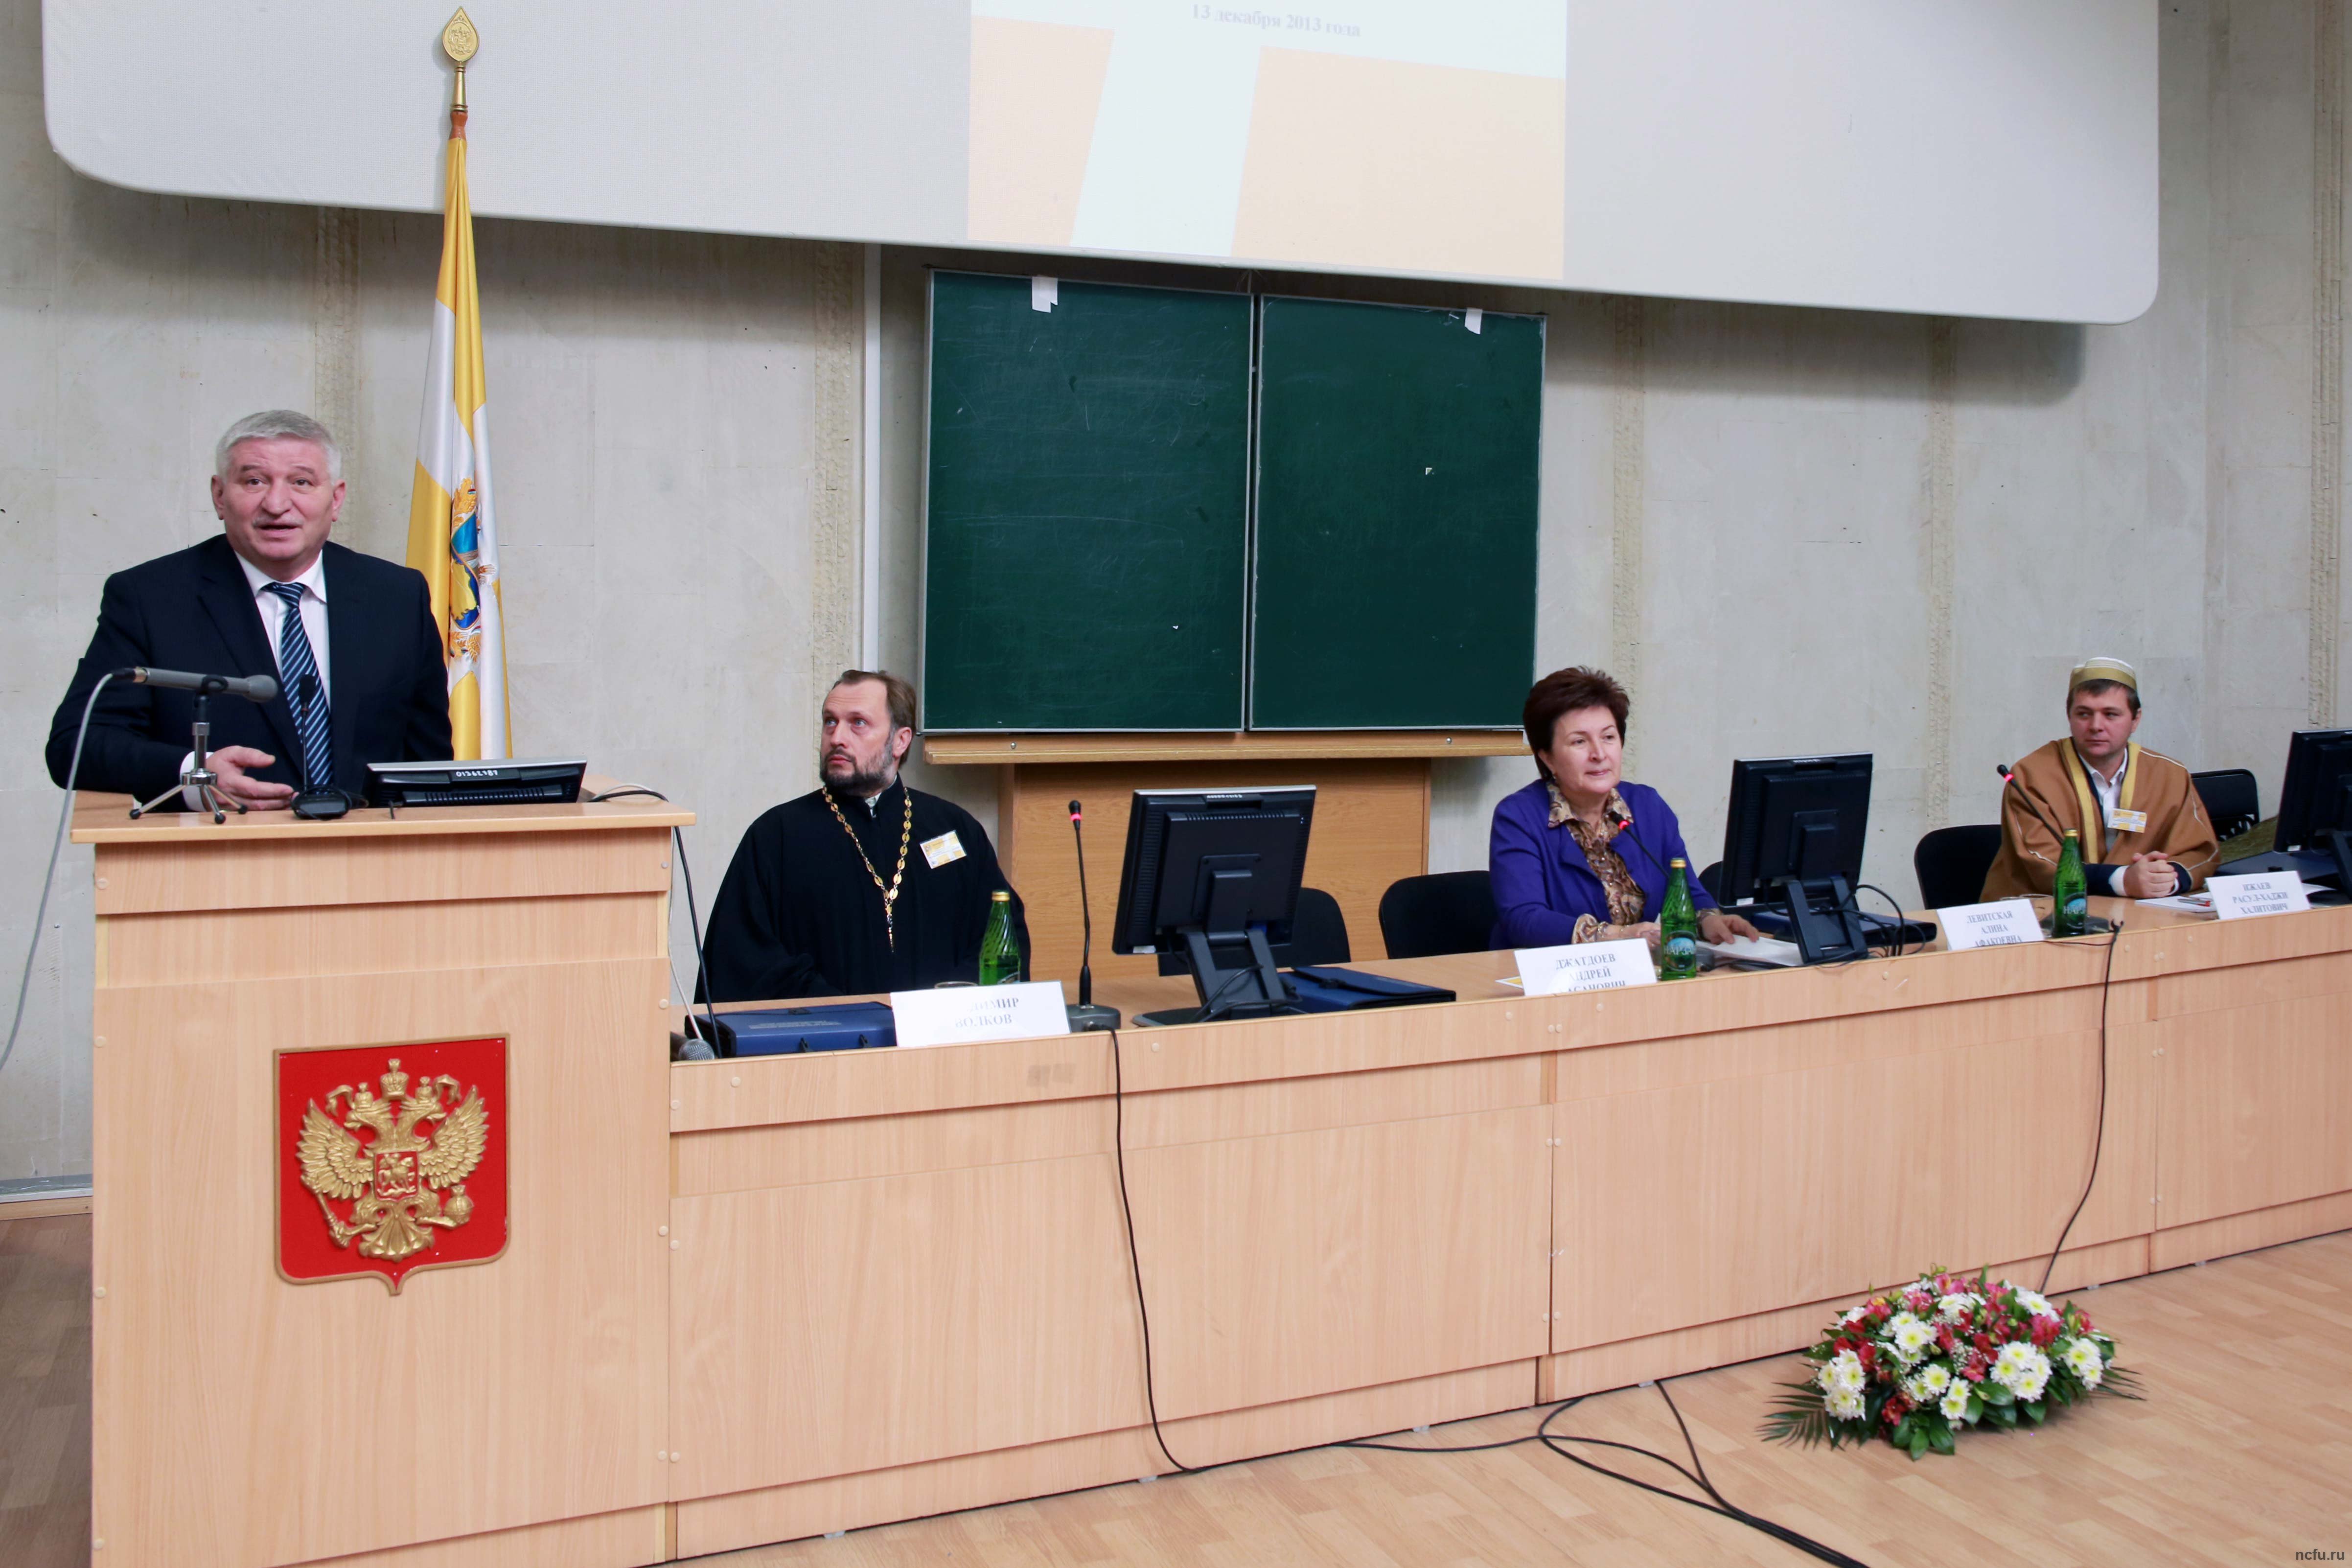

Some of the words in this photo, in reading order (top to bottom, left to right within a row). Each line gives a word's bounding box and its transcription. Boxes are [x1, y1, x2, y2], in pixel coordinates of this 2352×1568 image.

[1191, 4, 1211, 19] 13
[1214, 10, 1281, 29] декабря
[1286, 14, 1321, 32] 2013
[1325, 22, 1360, 37] года
[1966, 910, 2012, 923] ЛЕВИТСКАЯ
[1556, 953, 1616, 970] ДЖАТДОЕВ
